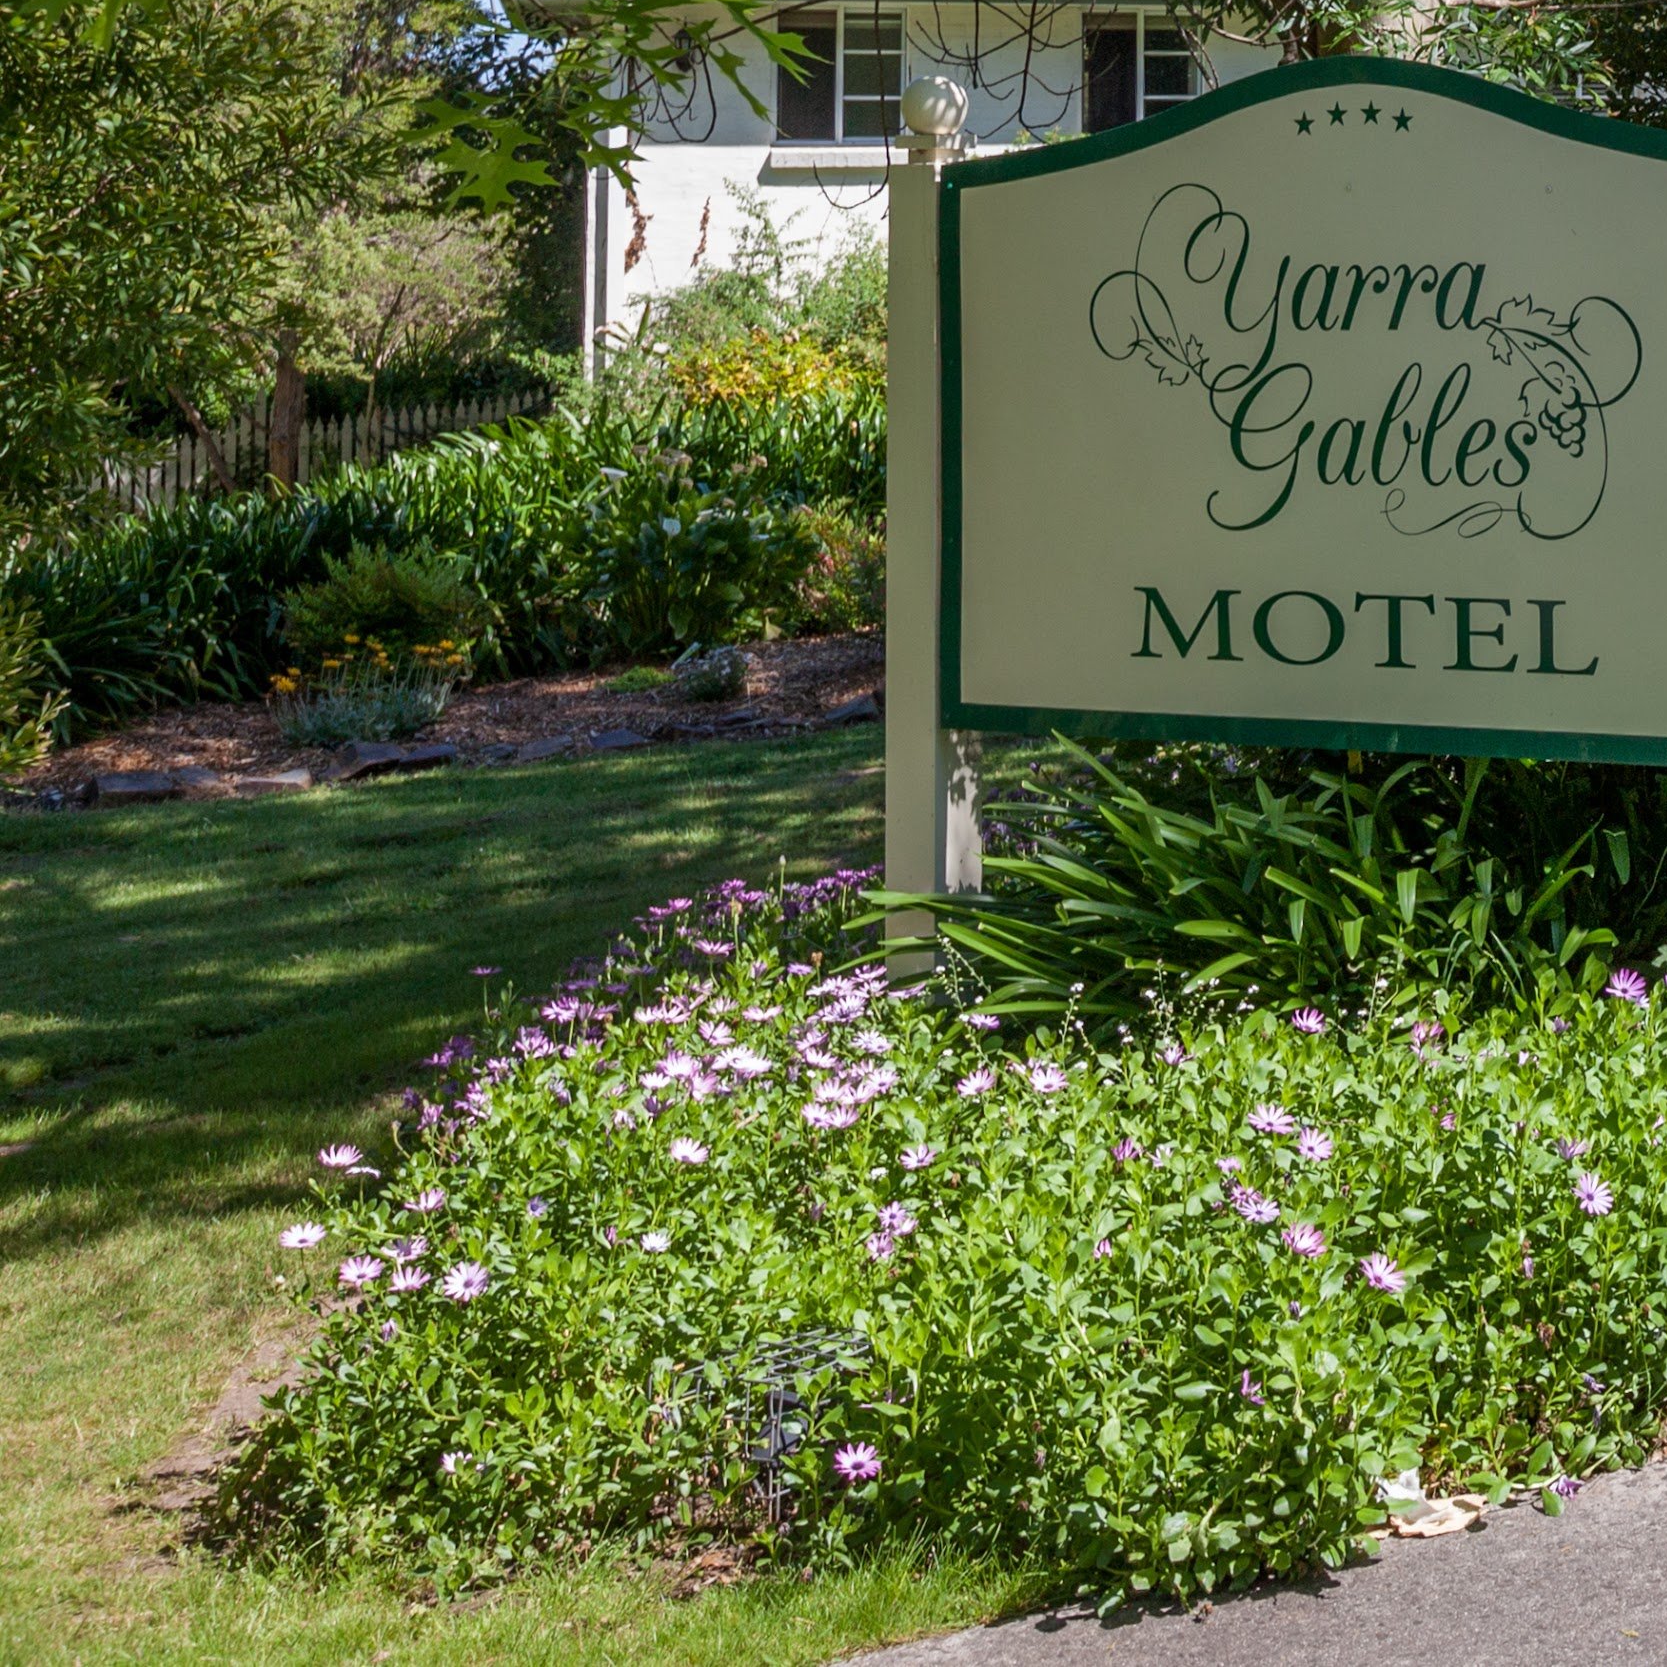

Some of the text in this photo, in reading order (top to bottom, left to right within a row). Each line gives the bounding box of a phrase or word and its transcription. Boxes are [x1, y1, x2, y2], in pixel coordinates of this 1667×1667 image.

[1184, 211, 1491, 392] Yarra
[1207, 362, 1538, 531] Gables
[1131, 586, 1599, 676] MOTEL
